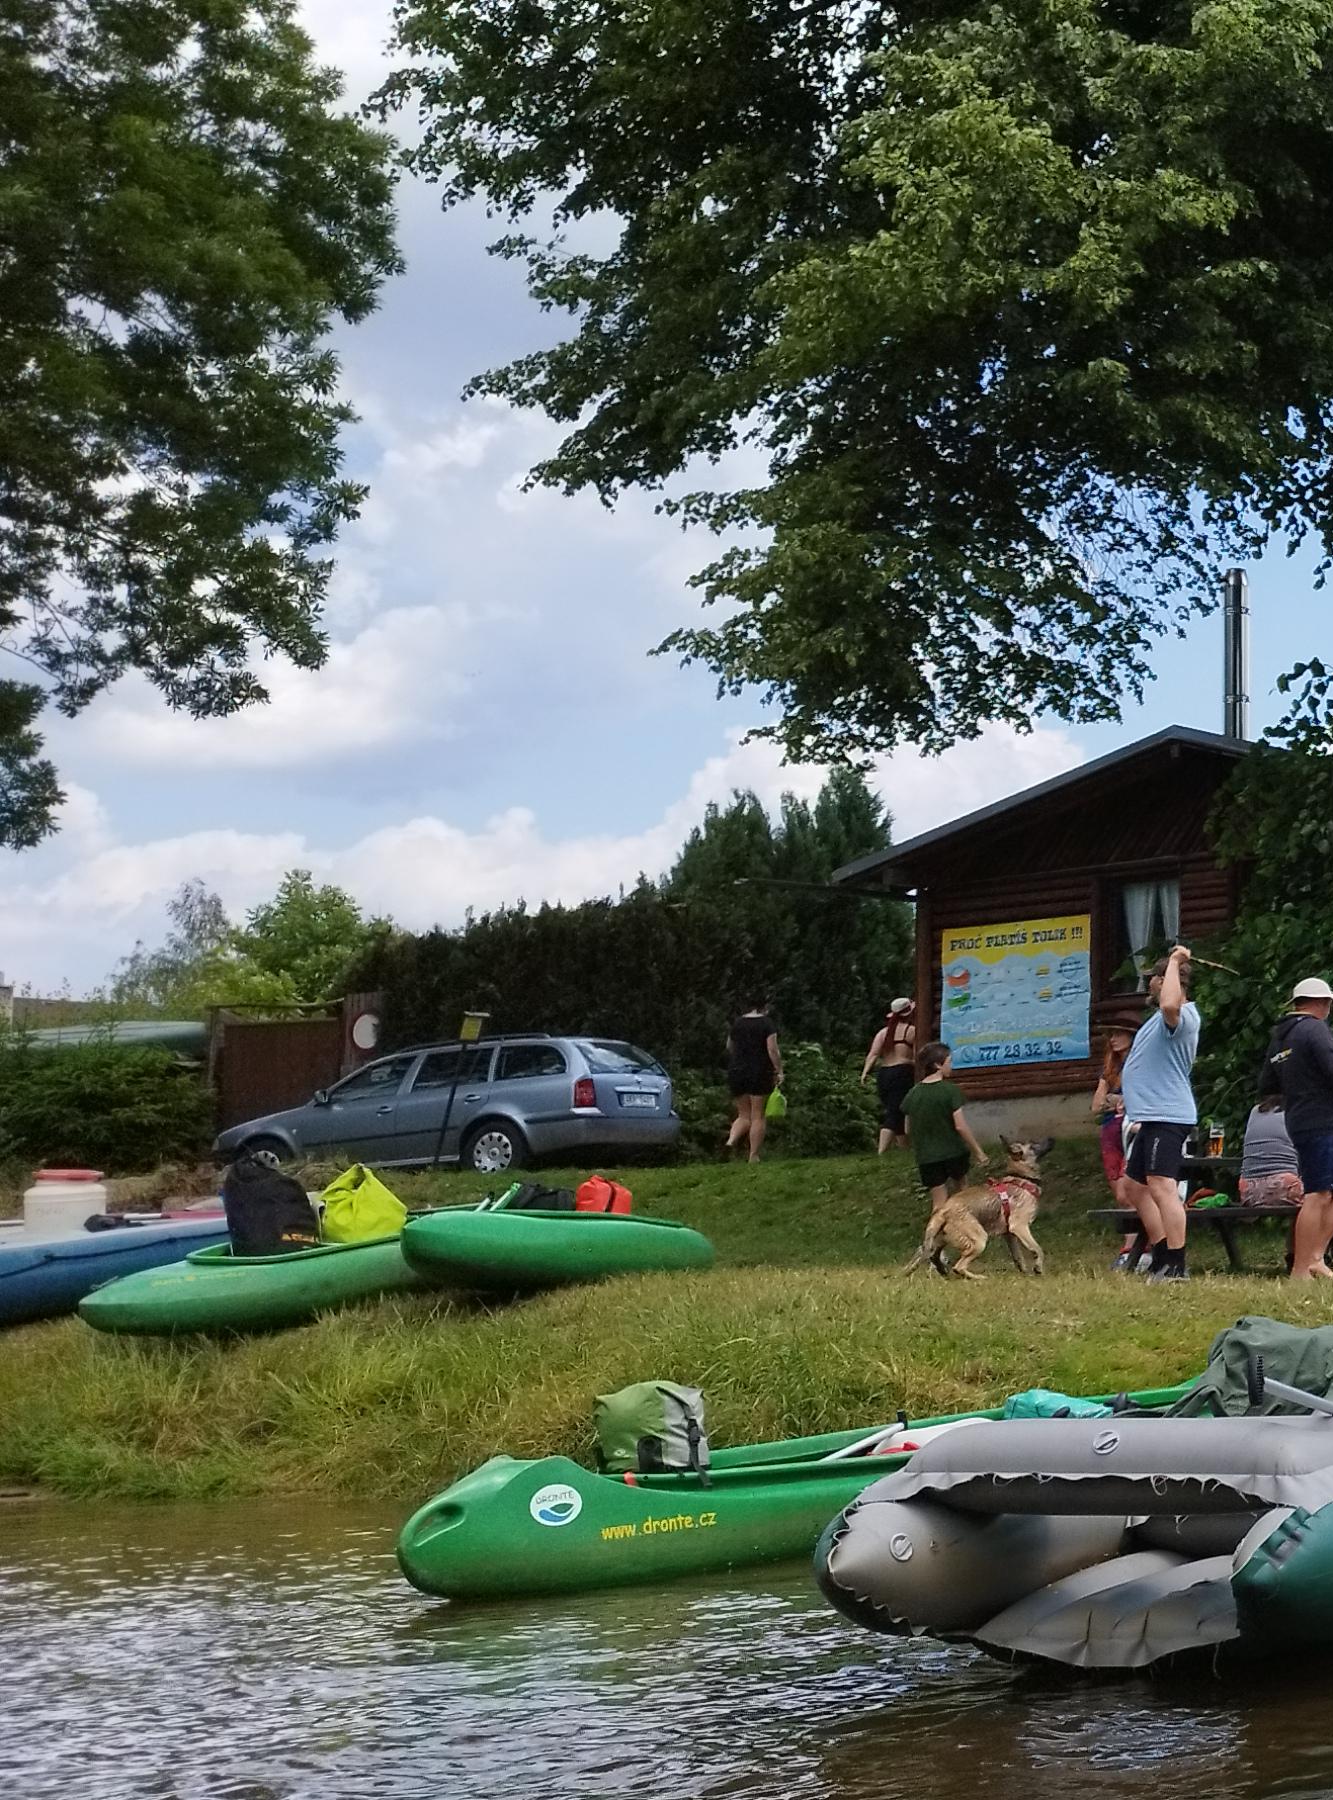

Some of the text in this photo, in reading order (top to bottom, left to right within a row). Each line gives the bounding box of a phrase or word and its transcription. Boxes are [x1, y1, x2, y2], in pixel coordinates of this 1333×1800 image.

[979, 1040, 1063, 1061] 777 28 32 32
[535, 1490, 575, 1505] DRONTE
[601, 1511, 718, 1541] www.dronte.cz
